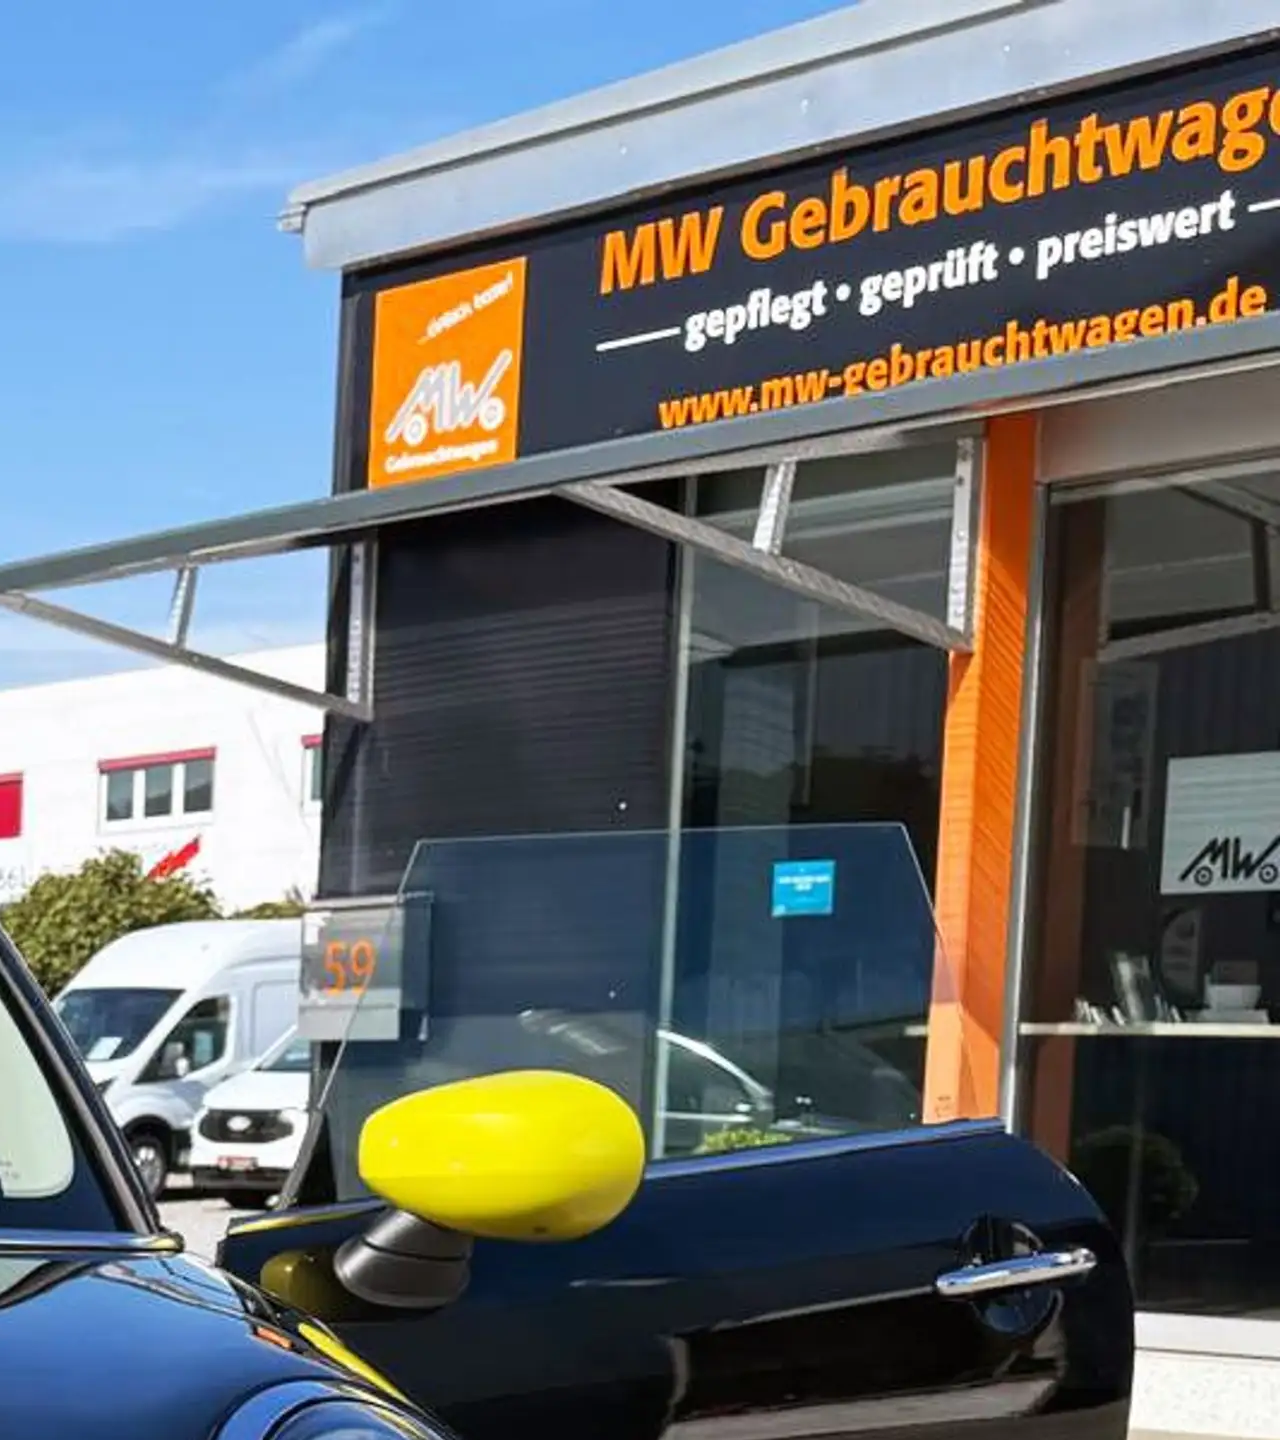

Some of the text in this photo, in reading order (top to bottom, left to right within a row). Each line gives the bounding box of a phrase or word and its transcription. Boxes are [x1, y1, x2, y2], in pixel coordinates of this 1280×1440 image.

[600, 88, 1280, 295] MW Gebrauchtwag
[685, 189, 1236, 351] gepflegt geprüft preiswert
